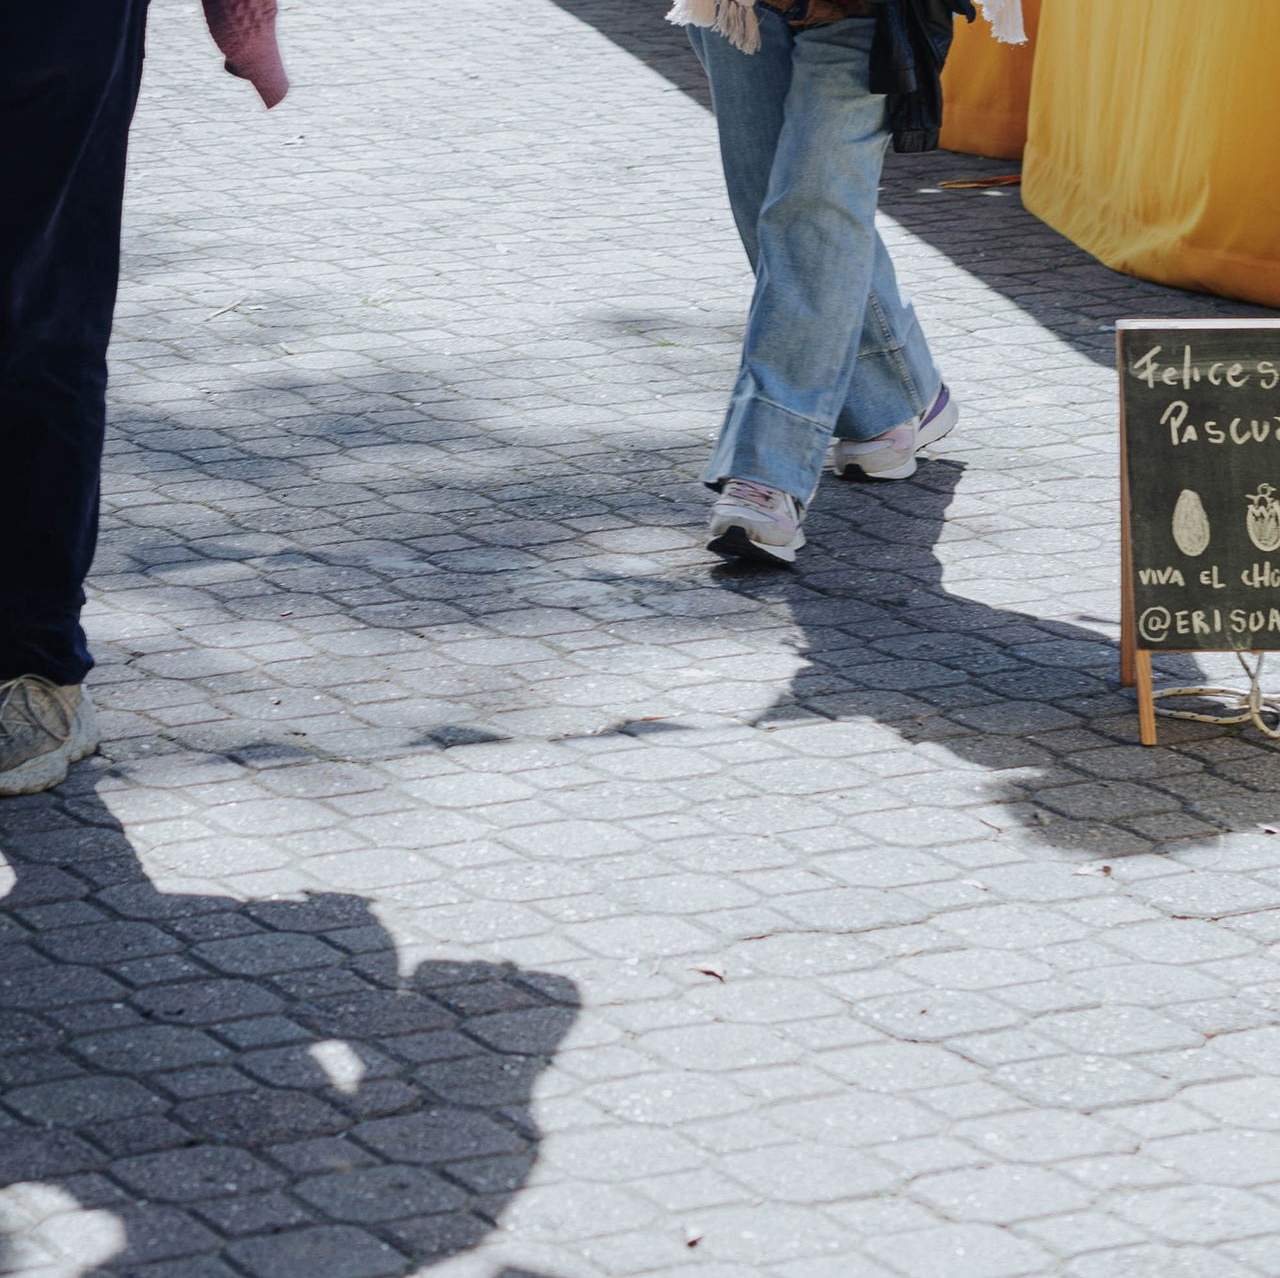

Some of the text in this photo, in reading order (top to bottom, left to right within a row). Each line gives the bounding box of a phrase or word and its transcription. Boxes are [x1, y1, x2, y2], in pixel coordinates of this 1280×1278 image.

[1133, 344, 1279, 389] Felices
[1138, 566, 1185, 587] VIVA
[1200, 565, 1226, 589] EL
